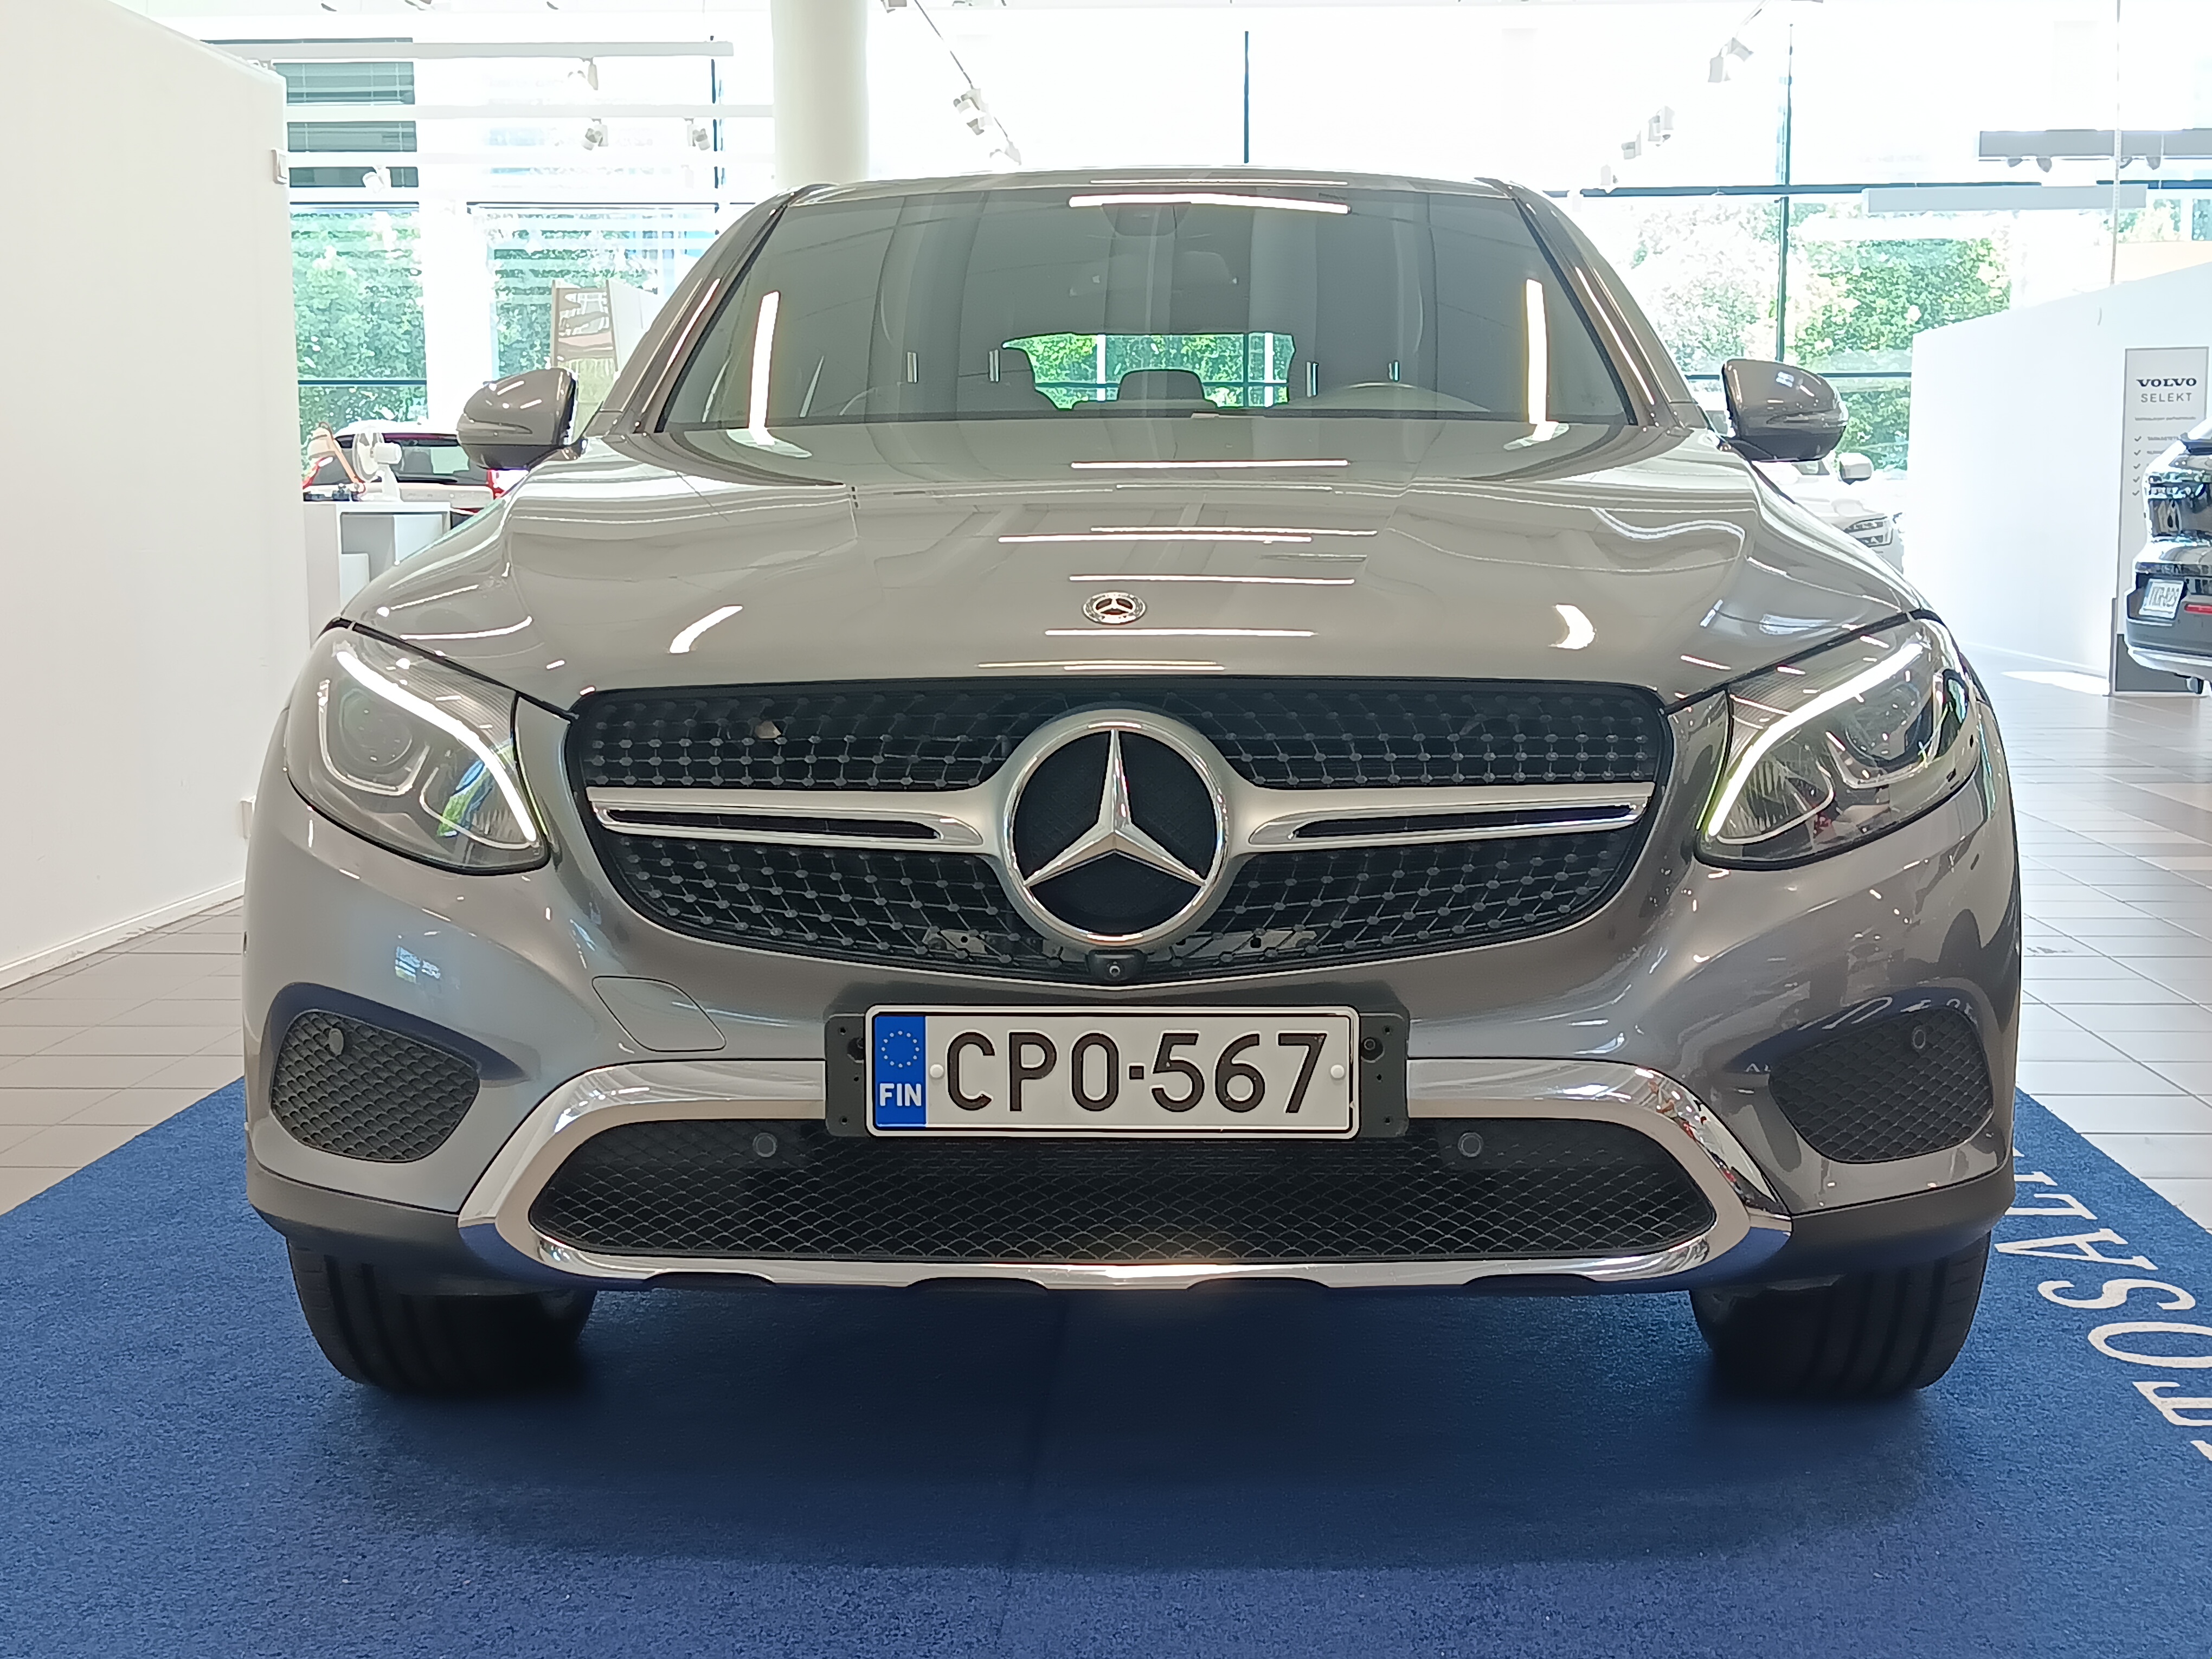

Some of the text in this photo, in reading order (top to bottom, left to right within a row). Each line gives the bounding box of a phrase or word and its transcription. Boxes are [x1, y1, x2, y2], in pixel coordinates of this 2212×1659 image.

[2136, 378, 2197, 387] VOLVO
[2140, 393, 2192, 403] SELEKT
[879, 1083, 922, 1107] FIN
